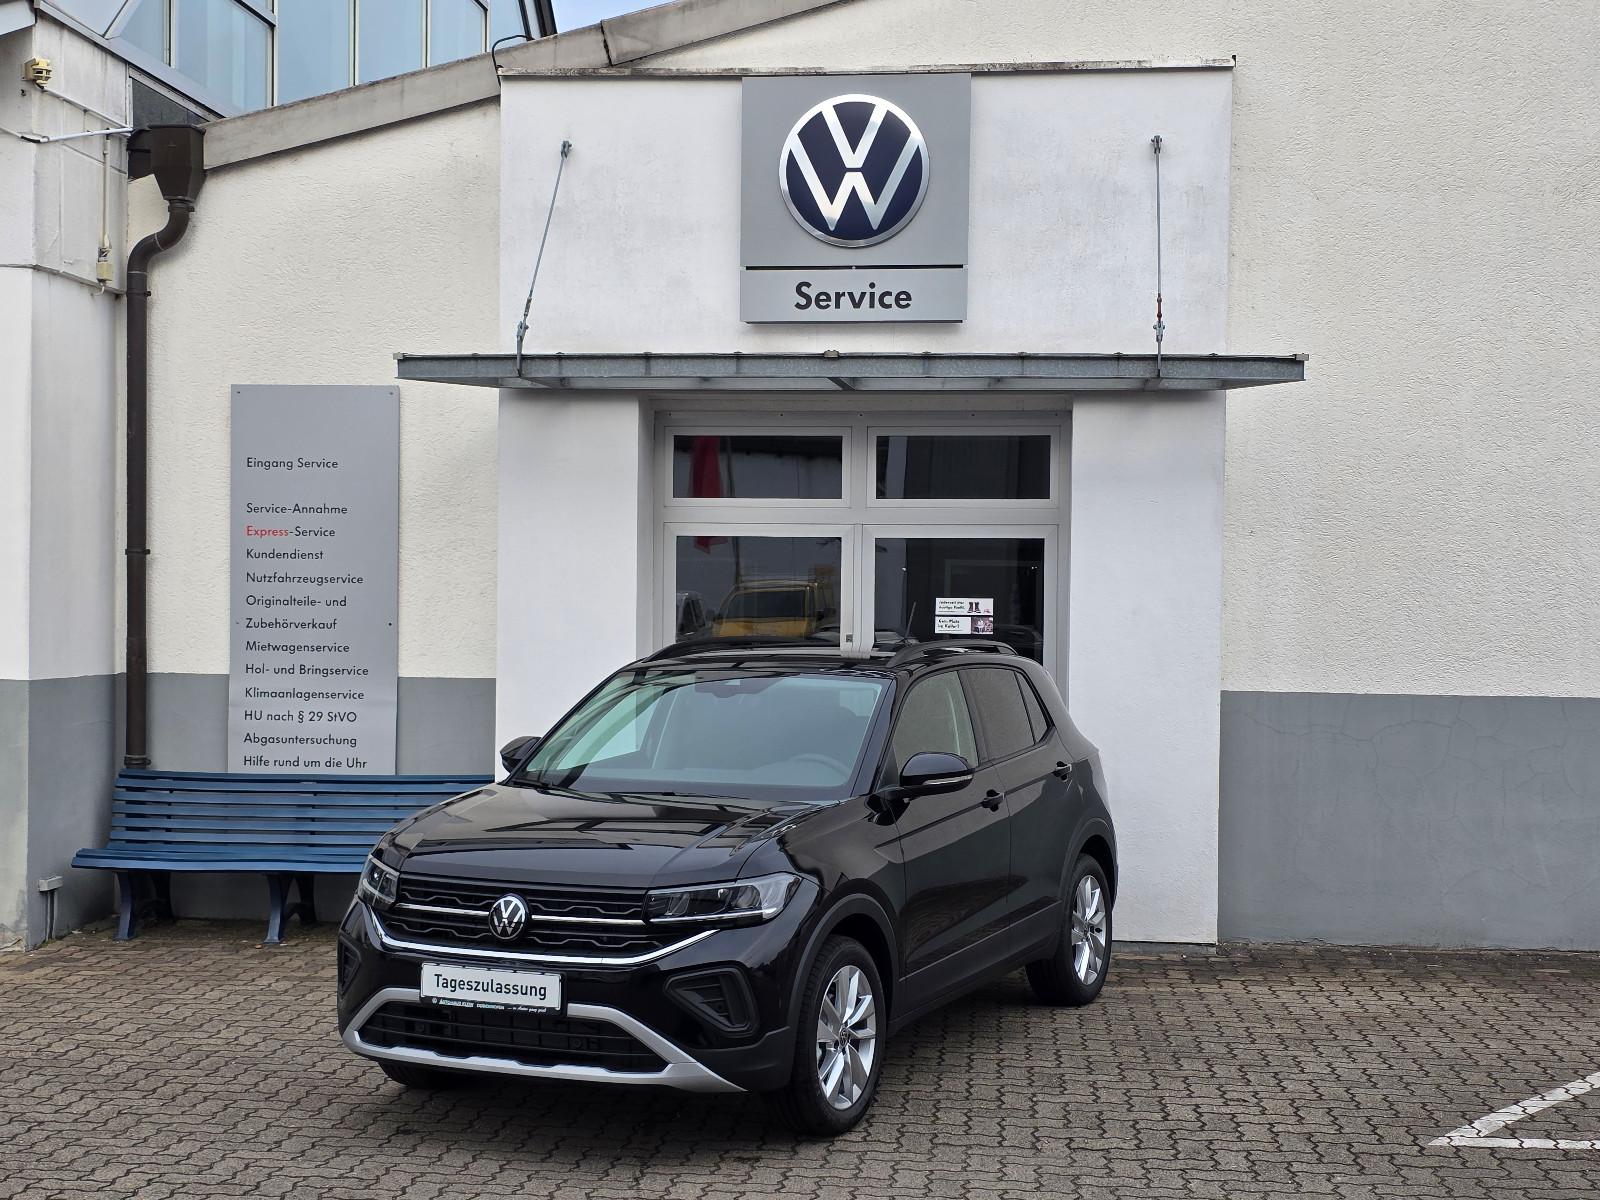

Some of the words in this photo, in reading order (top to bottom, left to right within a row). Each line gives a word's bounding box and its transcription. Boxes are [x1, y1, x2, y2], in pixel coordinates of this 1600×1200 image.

[783, 97, 928, 240] VW
[794, 281, 913, 310] Service
[246, 456, 294, 471] Eingang
[297, 457, 339, 469] Service
[246, 502, 348, 515] Service-Annahme
[246, 525, 336, 539] Express-Service
[246, 547, 324, 560] Kundendienst
[246, 571, 364, 587] Nutzfahrzeugservice
[245, 594, 321, 609] Originalteile-
[325, 595, 347, 607] und
[245, 617, 338, 630] Zubehörverkauf
[245, 640, 350, 655] Mietwagenservice
[245, 662, 270, 675] Hol-
[273, 663, 295, 675] und
[299, 663, 369, 678] Bringservice
[244, 686, 365, 702] Klimaanlagenservice
[244, 709, 263, 721] HU
[266, 709, 294, 722] nach
[297, 710, 305, 724] §
[308, 711, 324, 722] 29
[327, 711, 358, 723] StVO
[243, 732, 357, 748] Abgasuntersuchung
[243, 755, 270, 767] Hilfe
[273, 755, 300, 768] rund
[303, 760, 321, 768] um
[324, 756, 343, 769] die
[346, 757, 368, 769] Uhr
[490, 895, 525, 938] VW
[434, 973, 547, 1000] Tageszulassung
